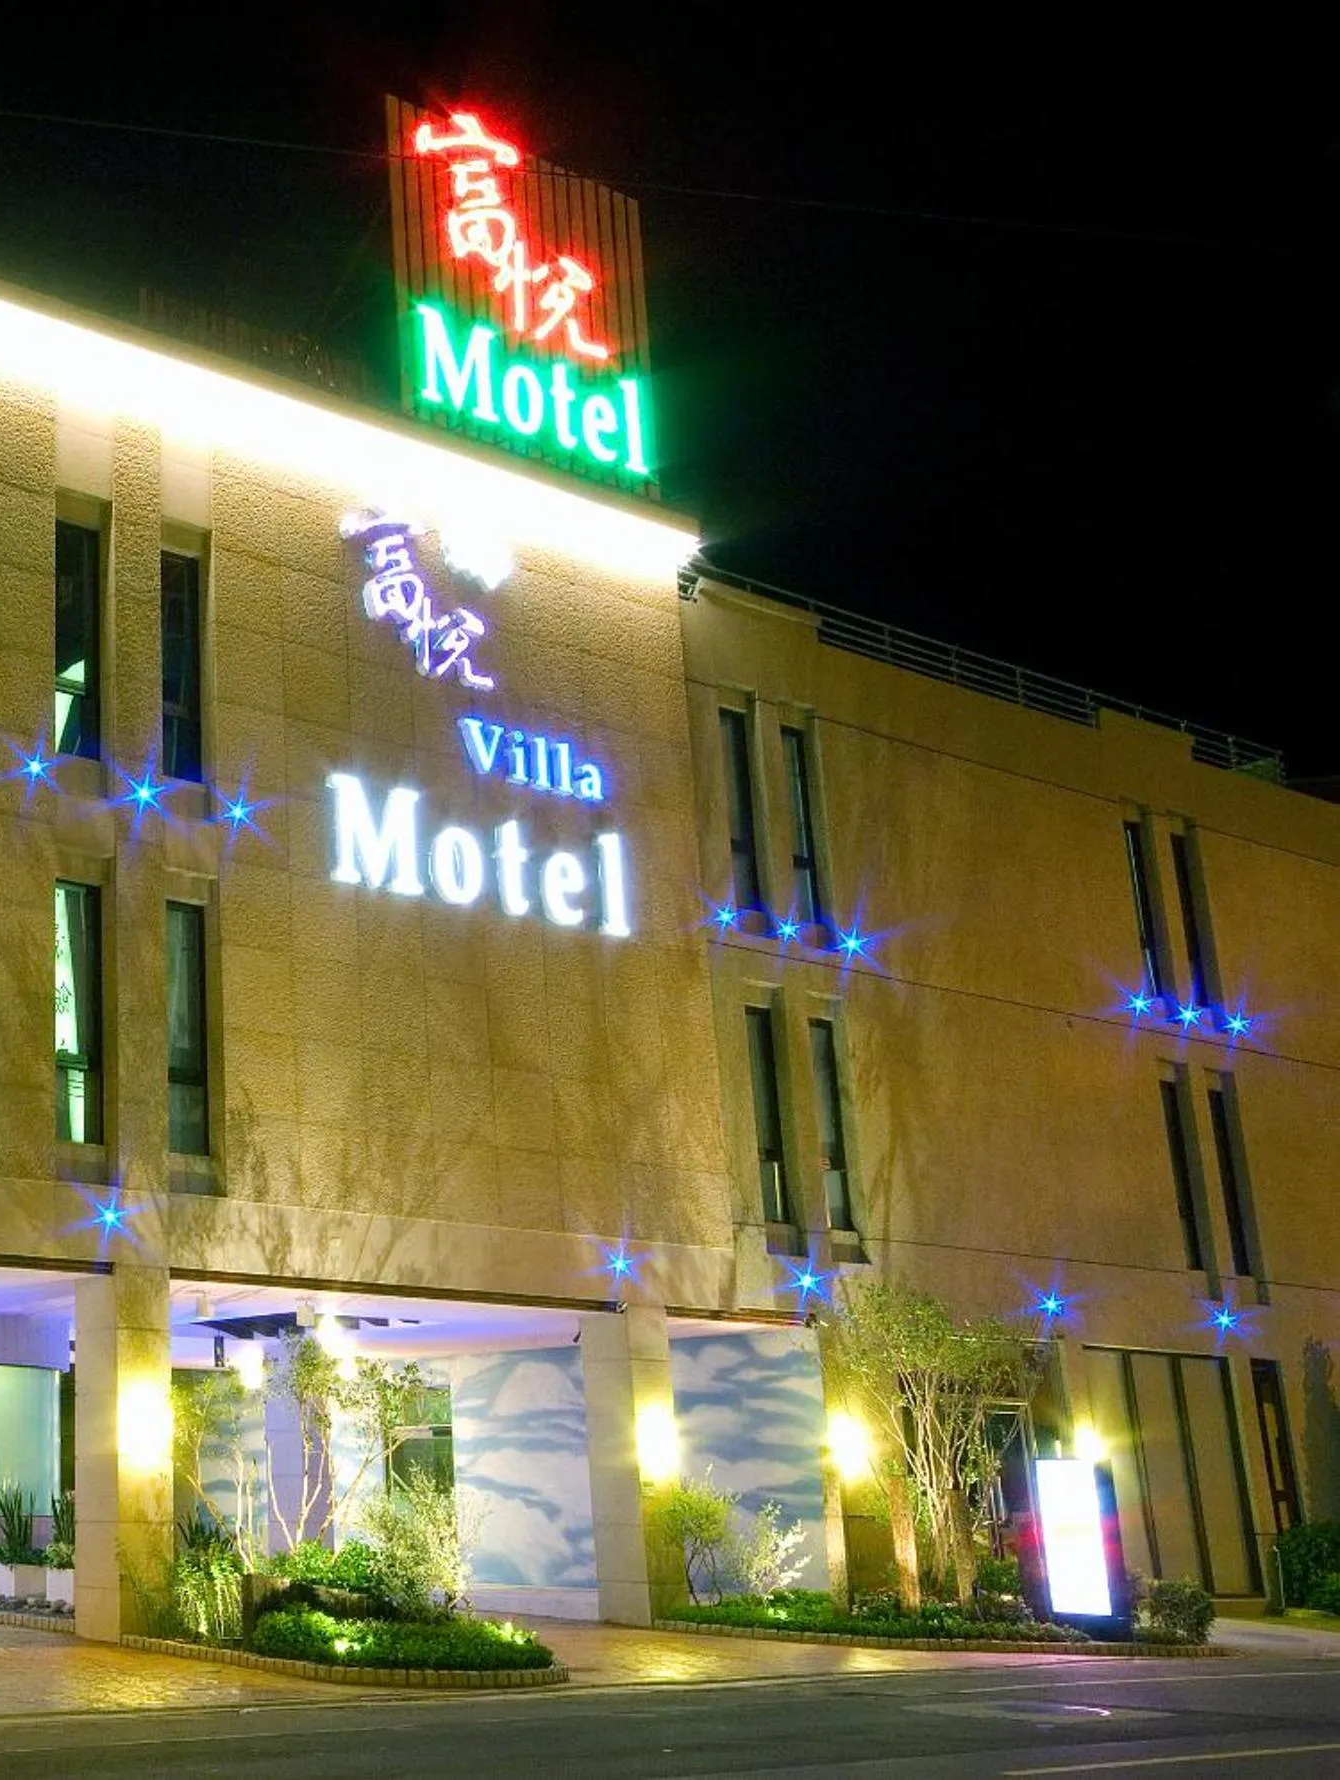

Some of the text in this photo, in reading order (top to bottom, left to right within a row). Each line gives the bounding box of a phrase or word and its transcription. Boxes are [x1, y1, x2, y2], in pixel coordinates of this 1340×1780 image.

[416, 303, 650, 475] Motel
[461, 717, 604, 800] Villa
[328, 773, 631, 937] Motel
